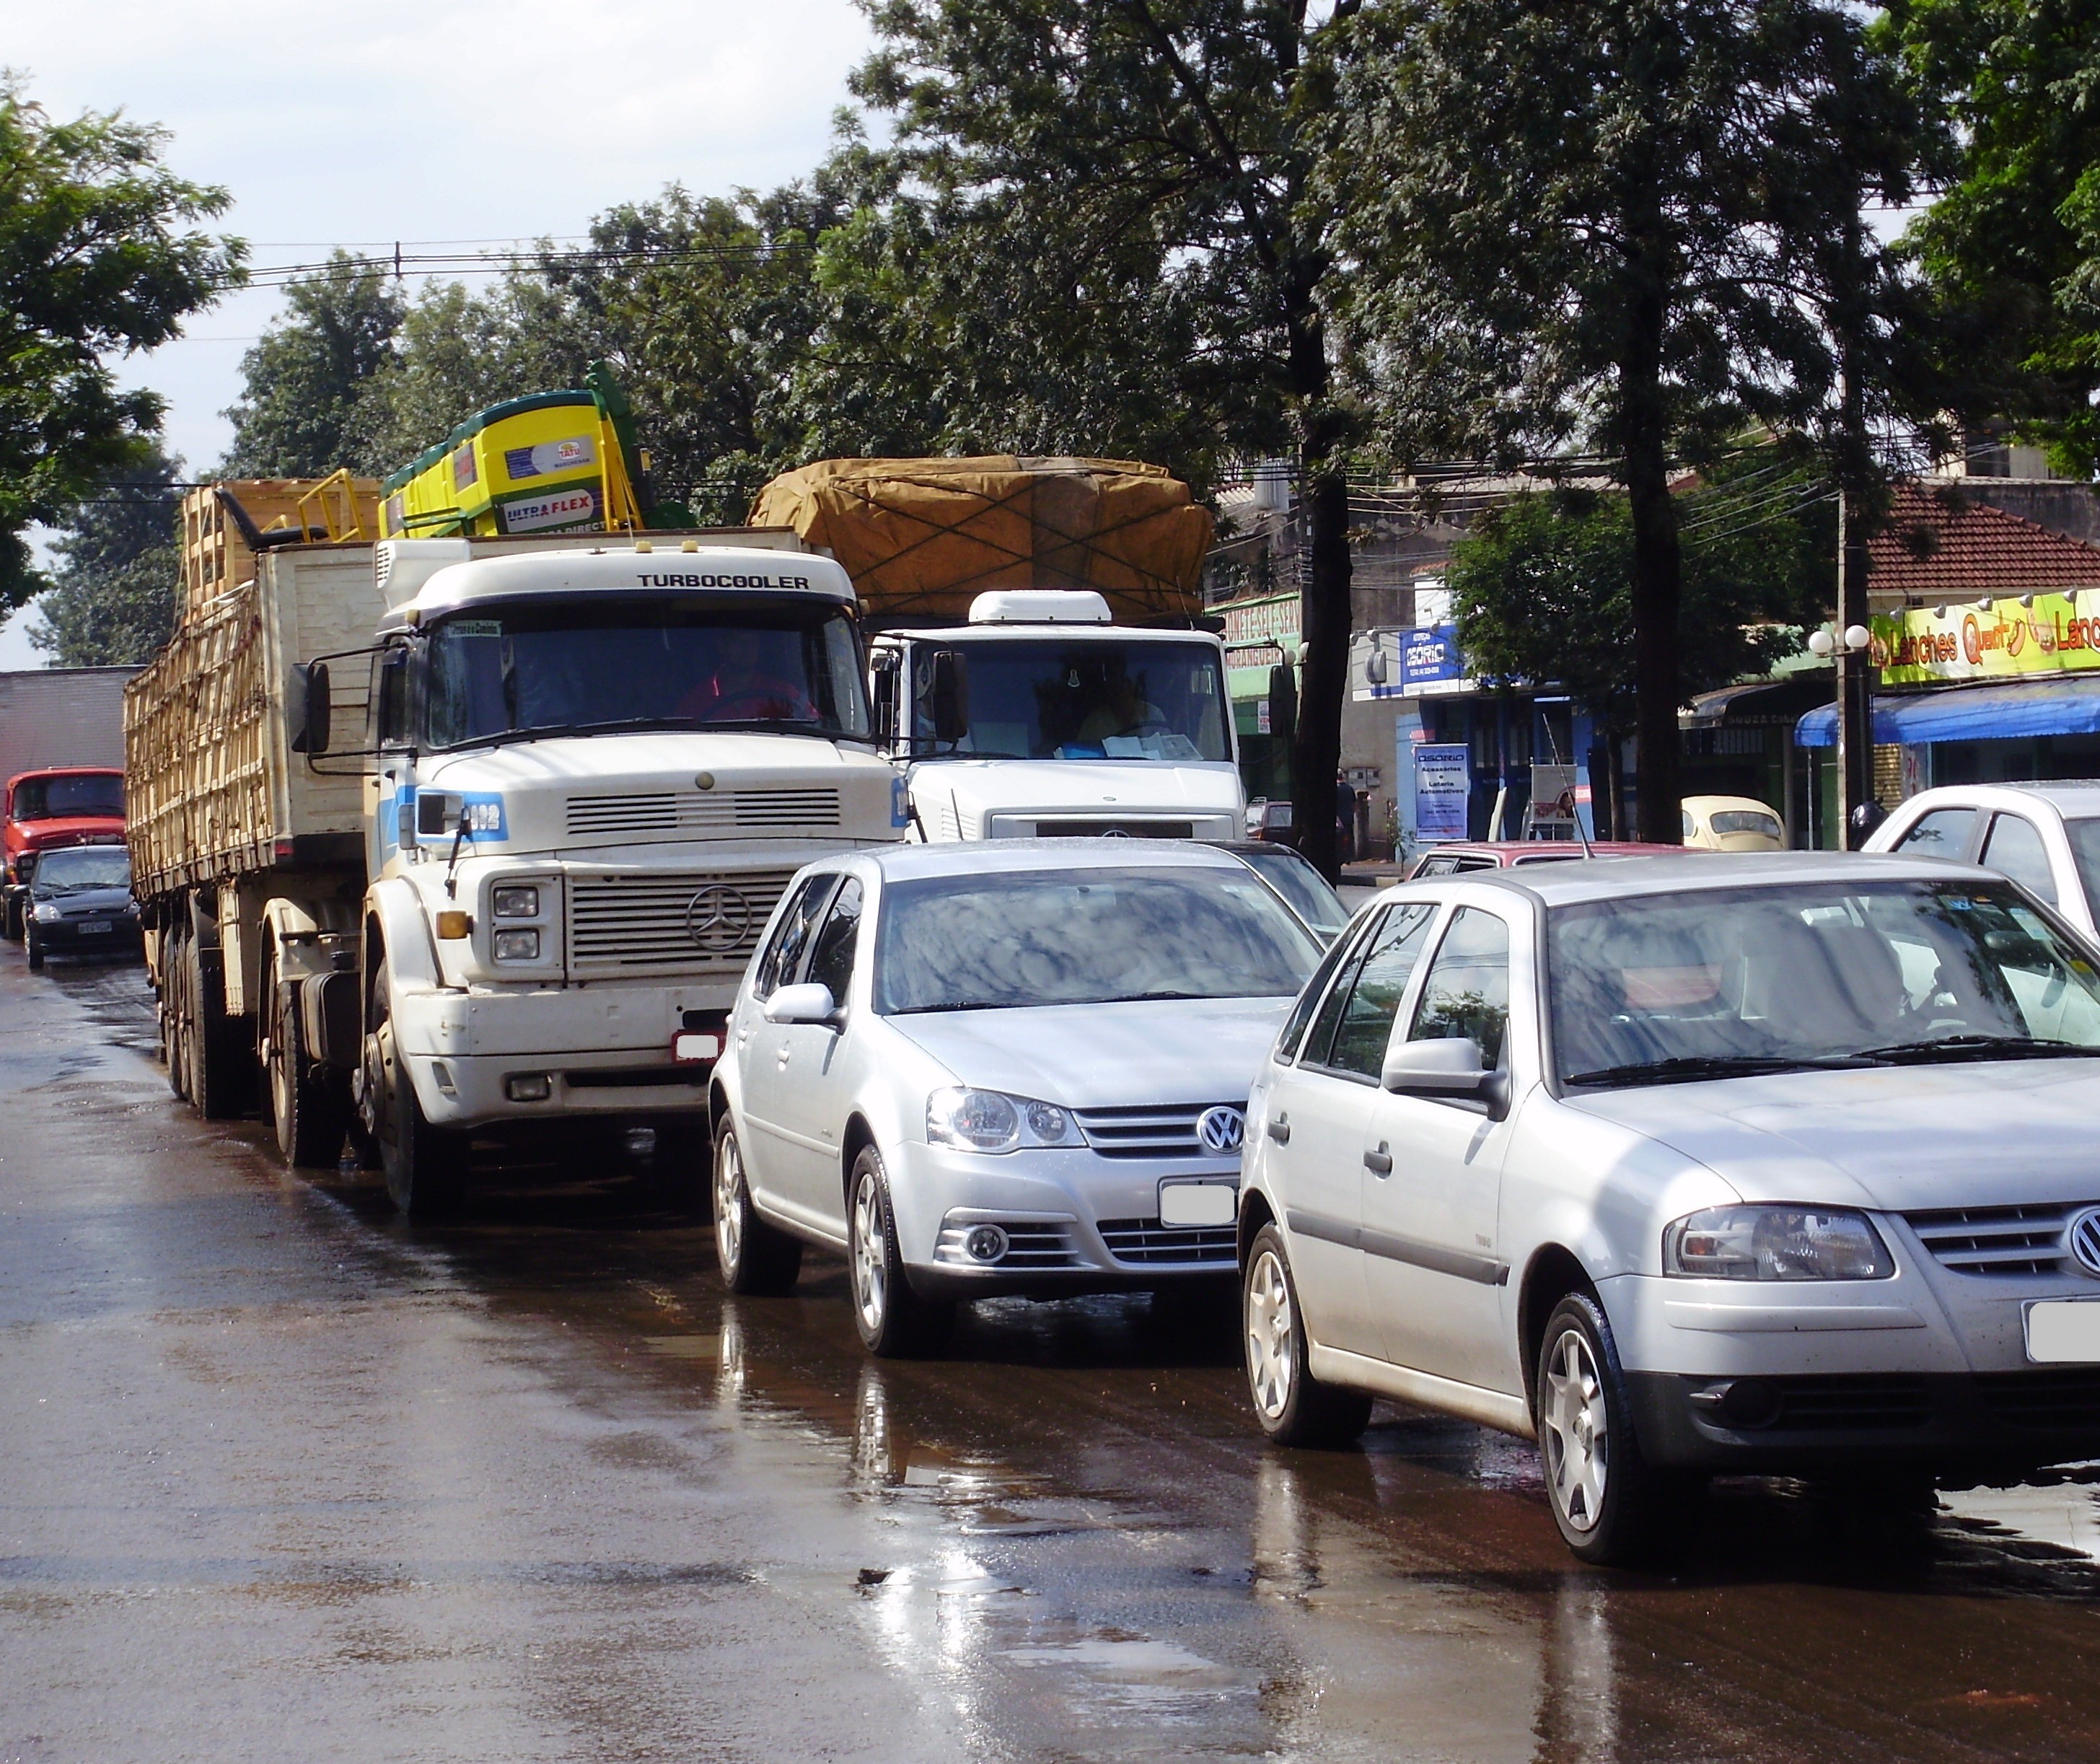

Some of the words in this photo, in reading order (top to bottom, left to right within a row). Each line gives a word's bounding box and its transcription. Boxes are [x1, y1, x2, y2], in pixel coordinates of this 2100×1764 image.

[559, 448, 580, 458] TATU
[637, 574, 809, 589] TURBOCOOLER
[1890, 626, 1958, 666] Lanches
